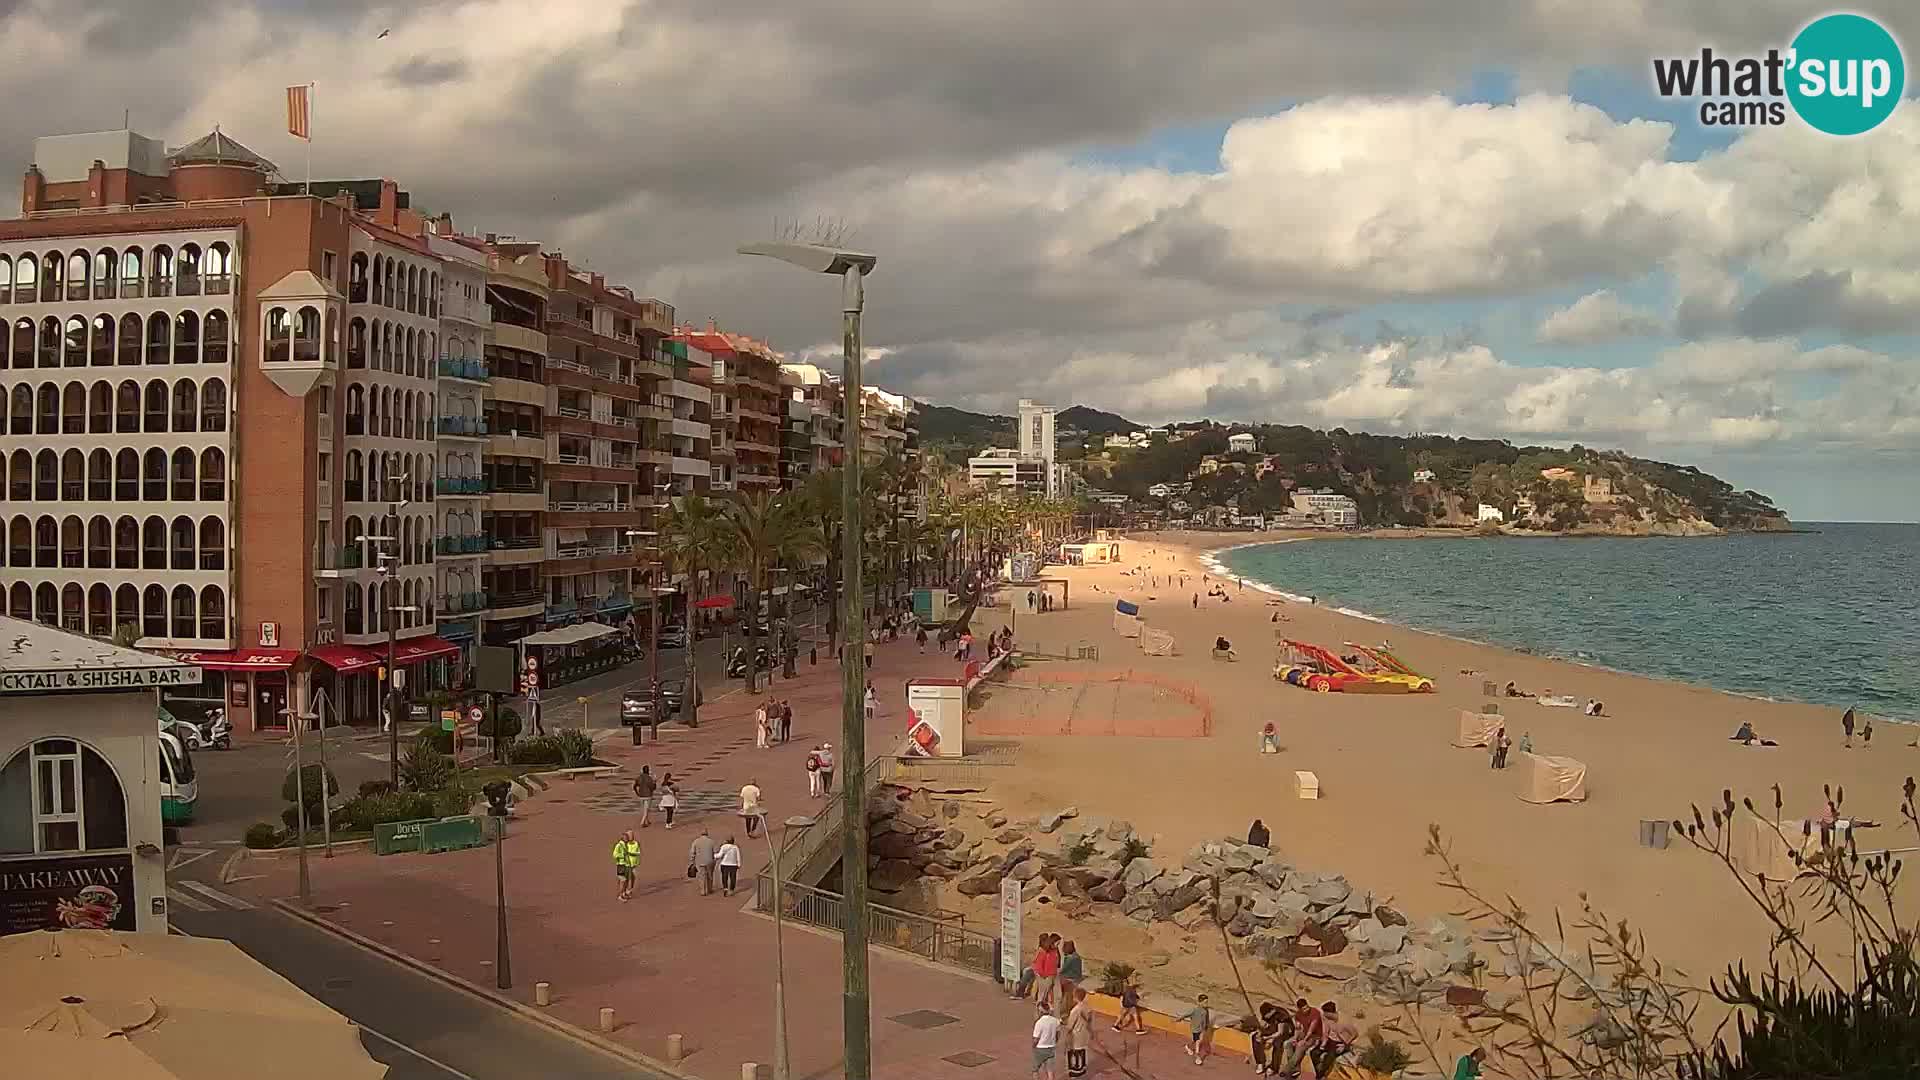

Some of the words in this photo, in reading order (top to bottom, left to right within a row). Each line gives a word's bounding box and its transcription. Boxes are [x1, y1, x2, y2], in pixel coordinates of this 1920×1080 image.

[317, 628, 336, 645] KFC
[246, 655, 282, 663] KFC
[0, 673, 61, 689] CKTAIL
[66, 674, 77, 687] &
[82, 671, 143, 687] SHISHA
[150, 669, 181, 684] BAR
[1, 866, 124, 891] TAKEAWAY
